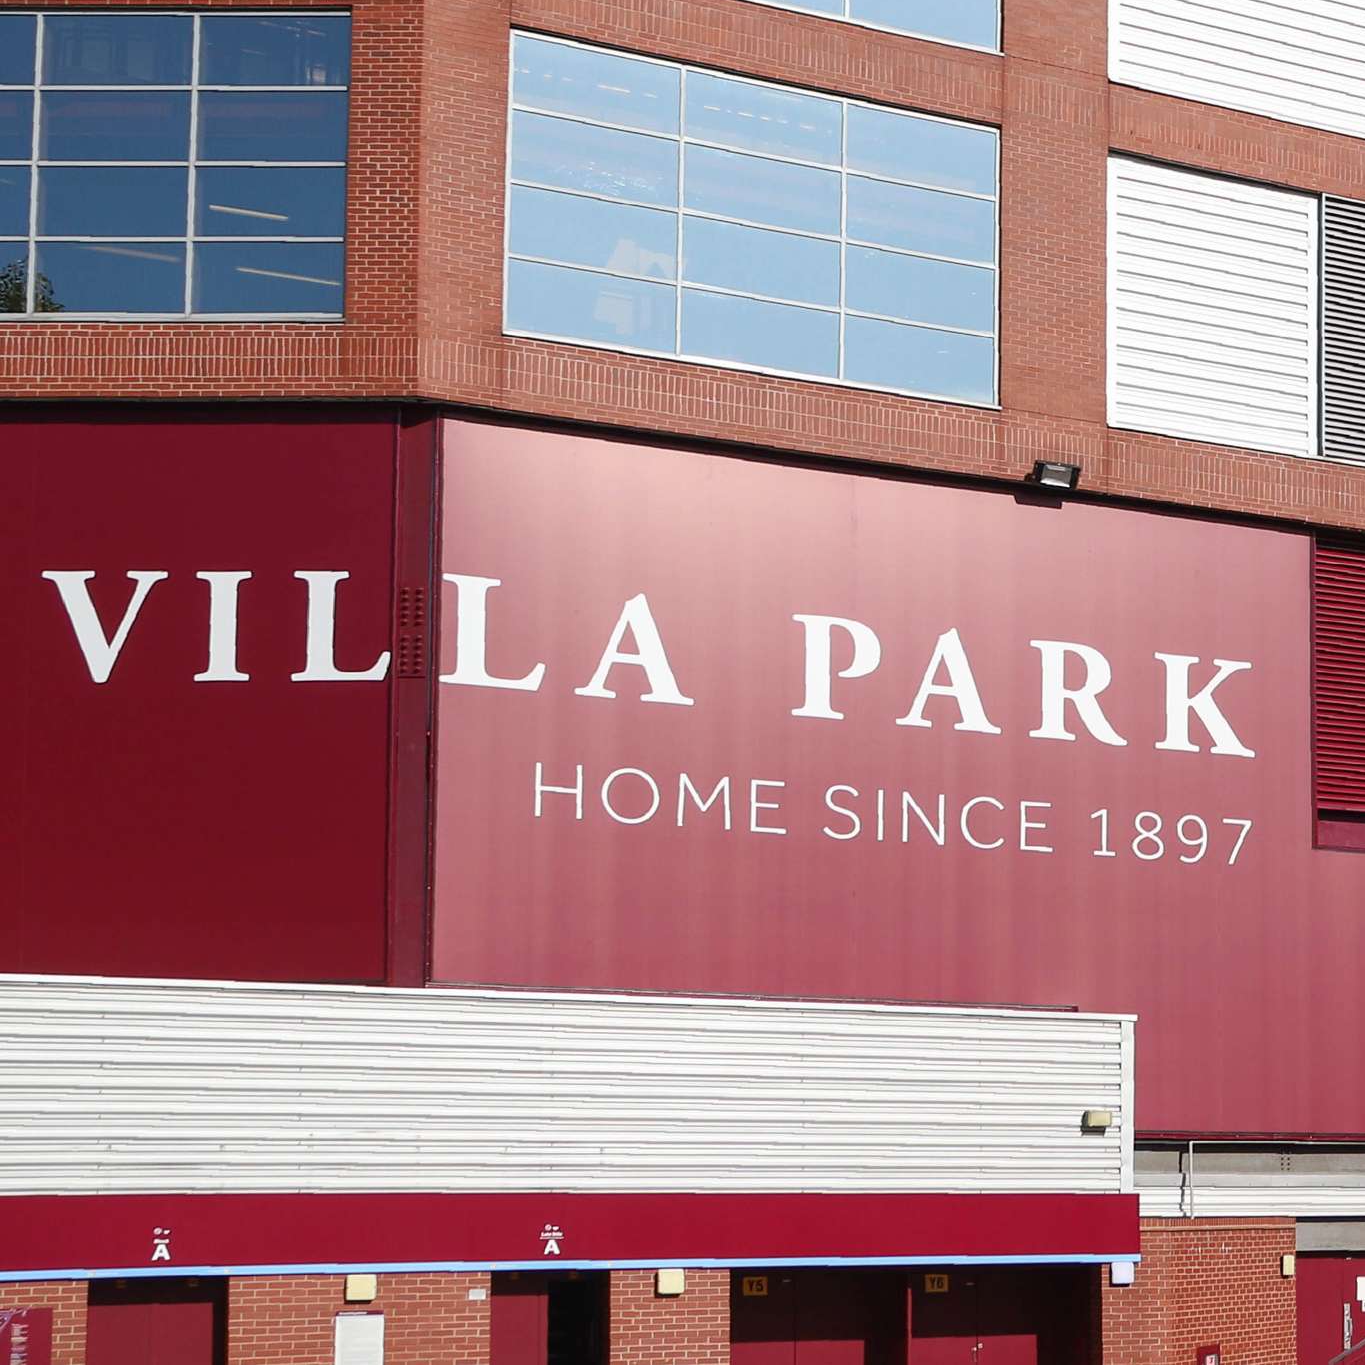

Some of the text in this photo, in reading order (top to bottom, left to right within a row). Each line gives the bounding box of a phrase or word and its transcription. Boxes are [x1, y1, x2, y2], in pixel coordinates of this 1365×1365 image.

[42, 569, 1256, 758] VILLA PARK
[533, 761, 1253, 866] HOME SINCE 1897
[151, 1243, 171, 1261] A
[543, 1239, 561, 1255] A
